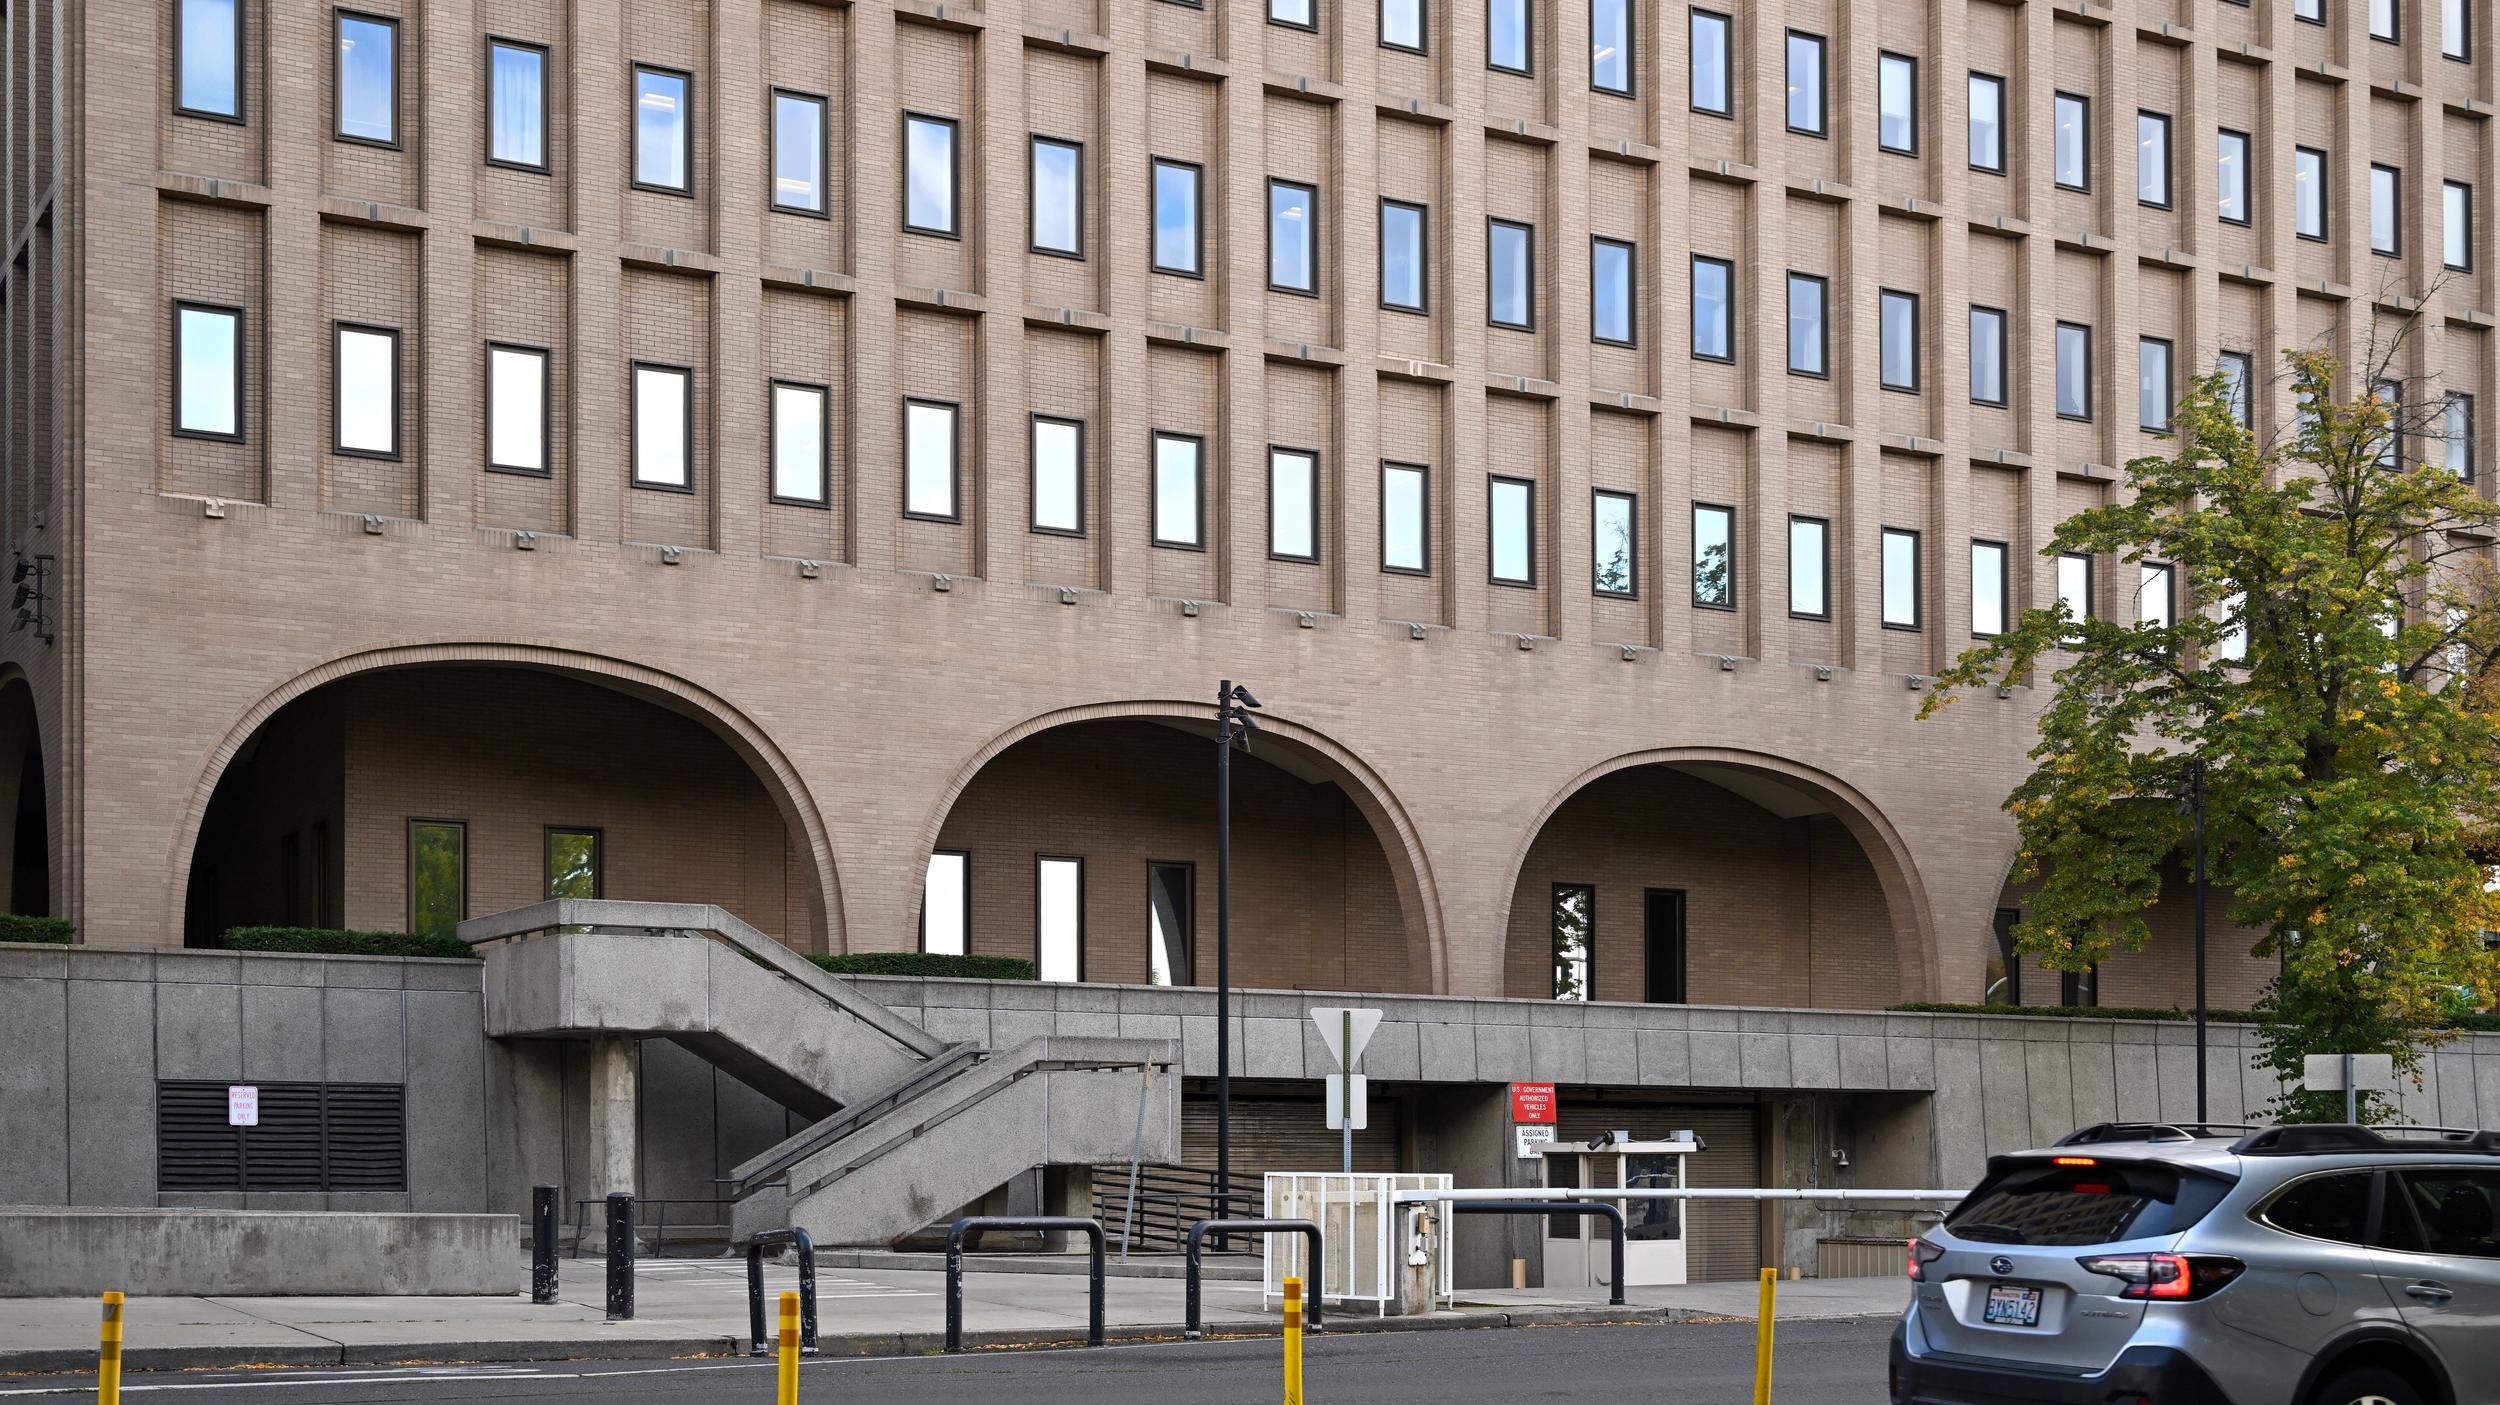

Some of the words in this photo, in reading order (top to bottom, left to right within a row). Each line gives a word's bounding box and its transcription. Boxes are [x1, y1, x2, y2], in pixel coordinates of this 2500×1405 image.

[234, 1102, 253, 1110] PARKING
[238, 1112, 250, 1120] ONLY
[1522, 1129, 1549, 1137] ASSIGNED
